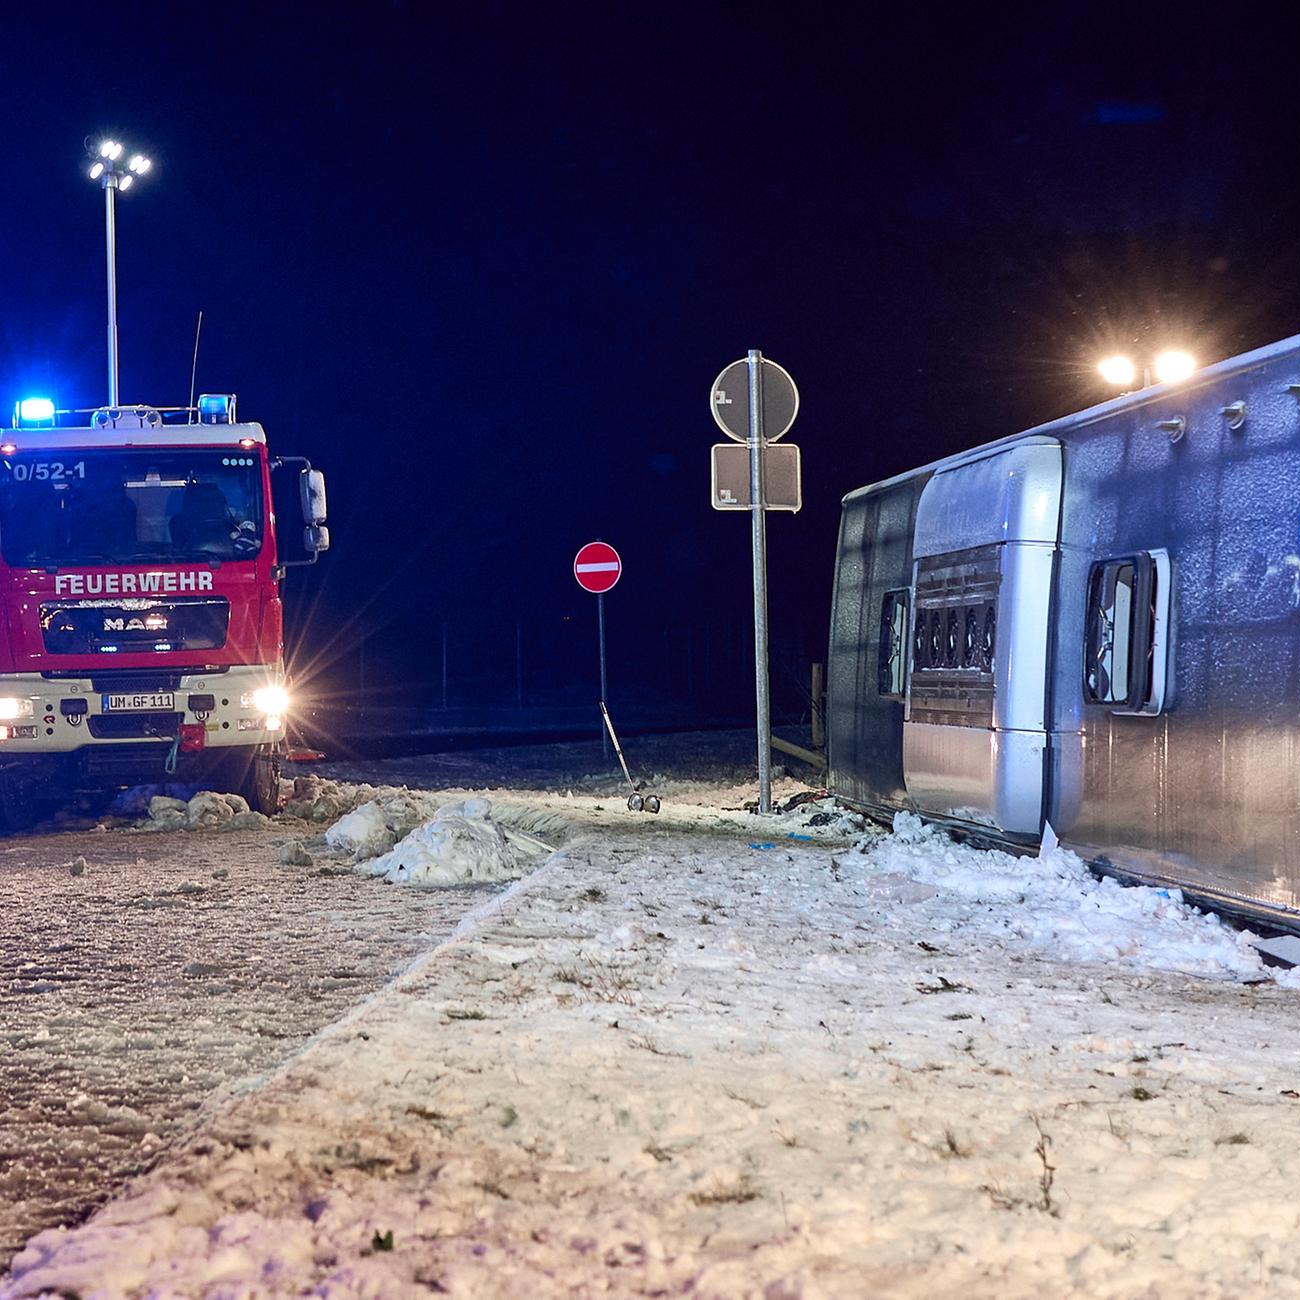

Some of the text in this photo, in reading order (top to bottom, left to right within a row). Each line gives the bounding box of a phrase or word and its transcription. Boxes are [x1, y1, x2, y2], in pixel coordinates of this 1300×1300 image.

[13, 461, 86, 481] 0/52-1
[55, 571, 213, 595] FEUERWEHR
[110, 695, 172, 708] UM GF 111
